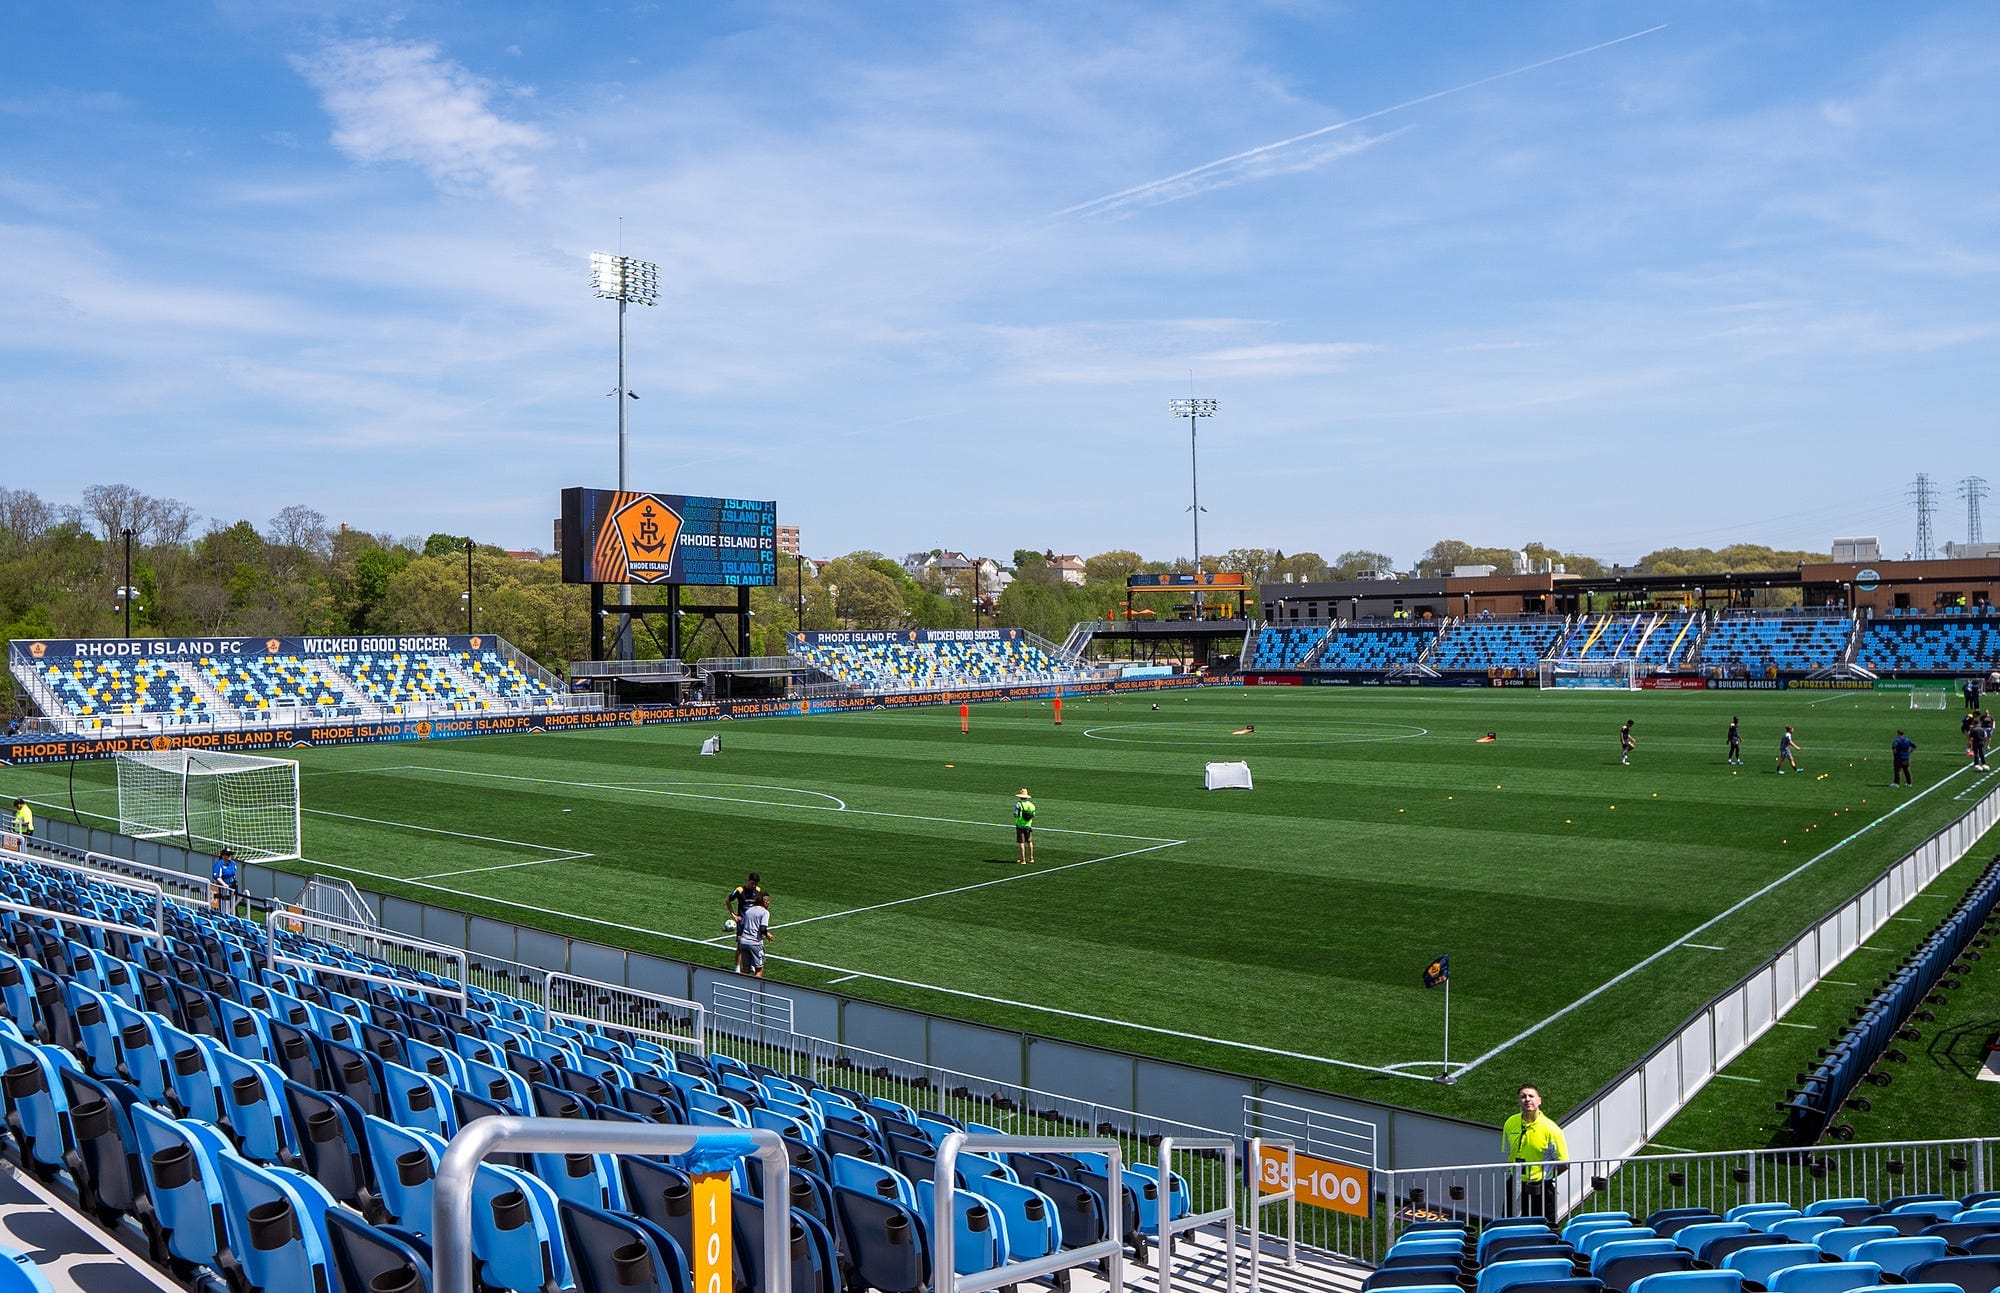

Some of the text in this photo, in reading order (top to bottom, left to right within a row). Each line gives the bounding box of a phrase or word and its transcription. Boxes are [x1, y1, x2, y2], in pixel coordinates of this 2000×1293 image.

[680, 534, 772, 549] RHODE ISLAND FC
[630, 561, 669, 571] RHODE ISLAND
[817, 632, 897, 643] RHODE ISLAND FC
[927, 631, 954, 641] WICKED
[955, 630, 973, 641] GOOD
[75, 641, 241, 656] RHODE ISLAND FC
[303, 637, 451, 653] WICKED GOOD SOCCER.
[1718, 681, 1748, 689] BUILDING
[1749, 681, 1777, 689] CAREERS
[1799, 680, 1830, 689] FROZEN
[1831, 680, 1873, 689] LEMONADE
[643, 707, 720, 720] RHODE ISLAND FC
[732, 702, 801, 714] RHODE ISLAND FC
[435, 717, 531, 732] RHODE ISLAND FC
[545, 711, 631, 726] RHODE ISLAND FC
[172, 730, 293, 748] RHODE ISLAND FC
[311, 724, 417, 740] RHODE ISLAND FC
[12, 738, 150, 758] RHODE ISLAND FC
